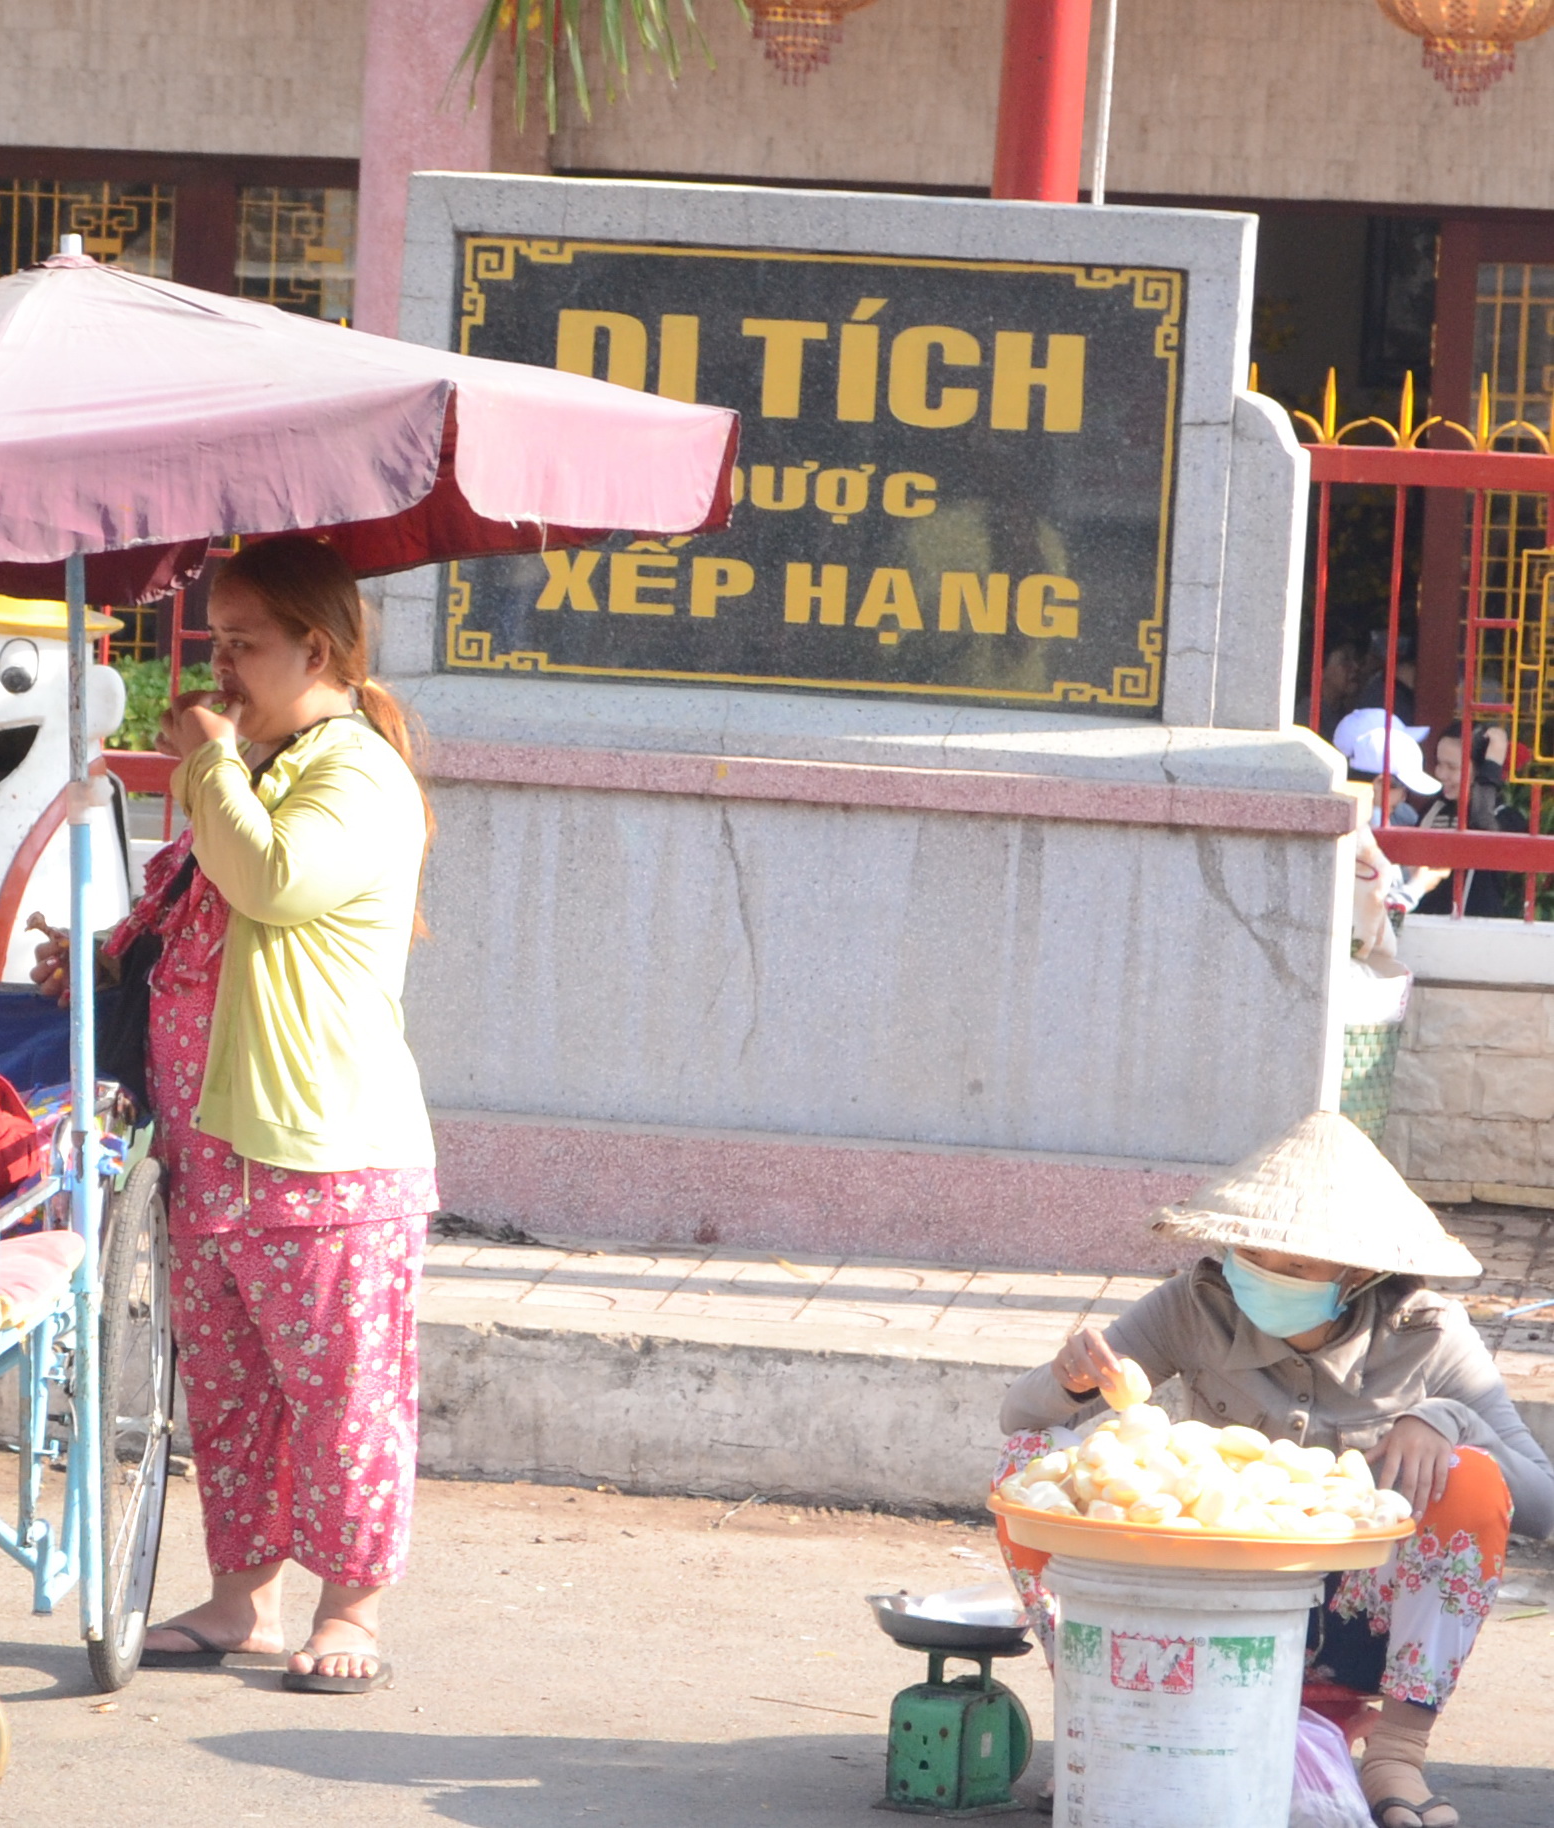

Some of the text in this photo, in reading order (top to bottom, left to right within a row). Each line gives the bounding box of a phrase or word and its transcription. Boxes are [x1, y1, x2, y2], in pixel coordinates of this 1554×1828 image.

[555, 297, 1086, 434] DI TÍCH
[732, 460, 937, 525] ƯỢC
[535, 536, 1082, 646] XẾP HẠNG
